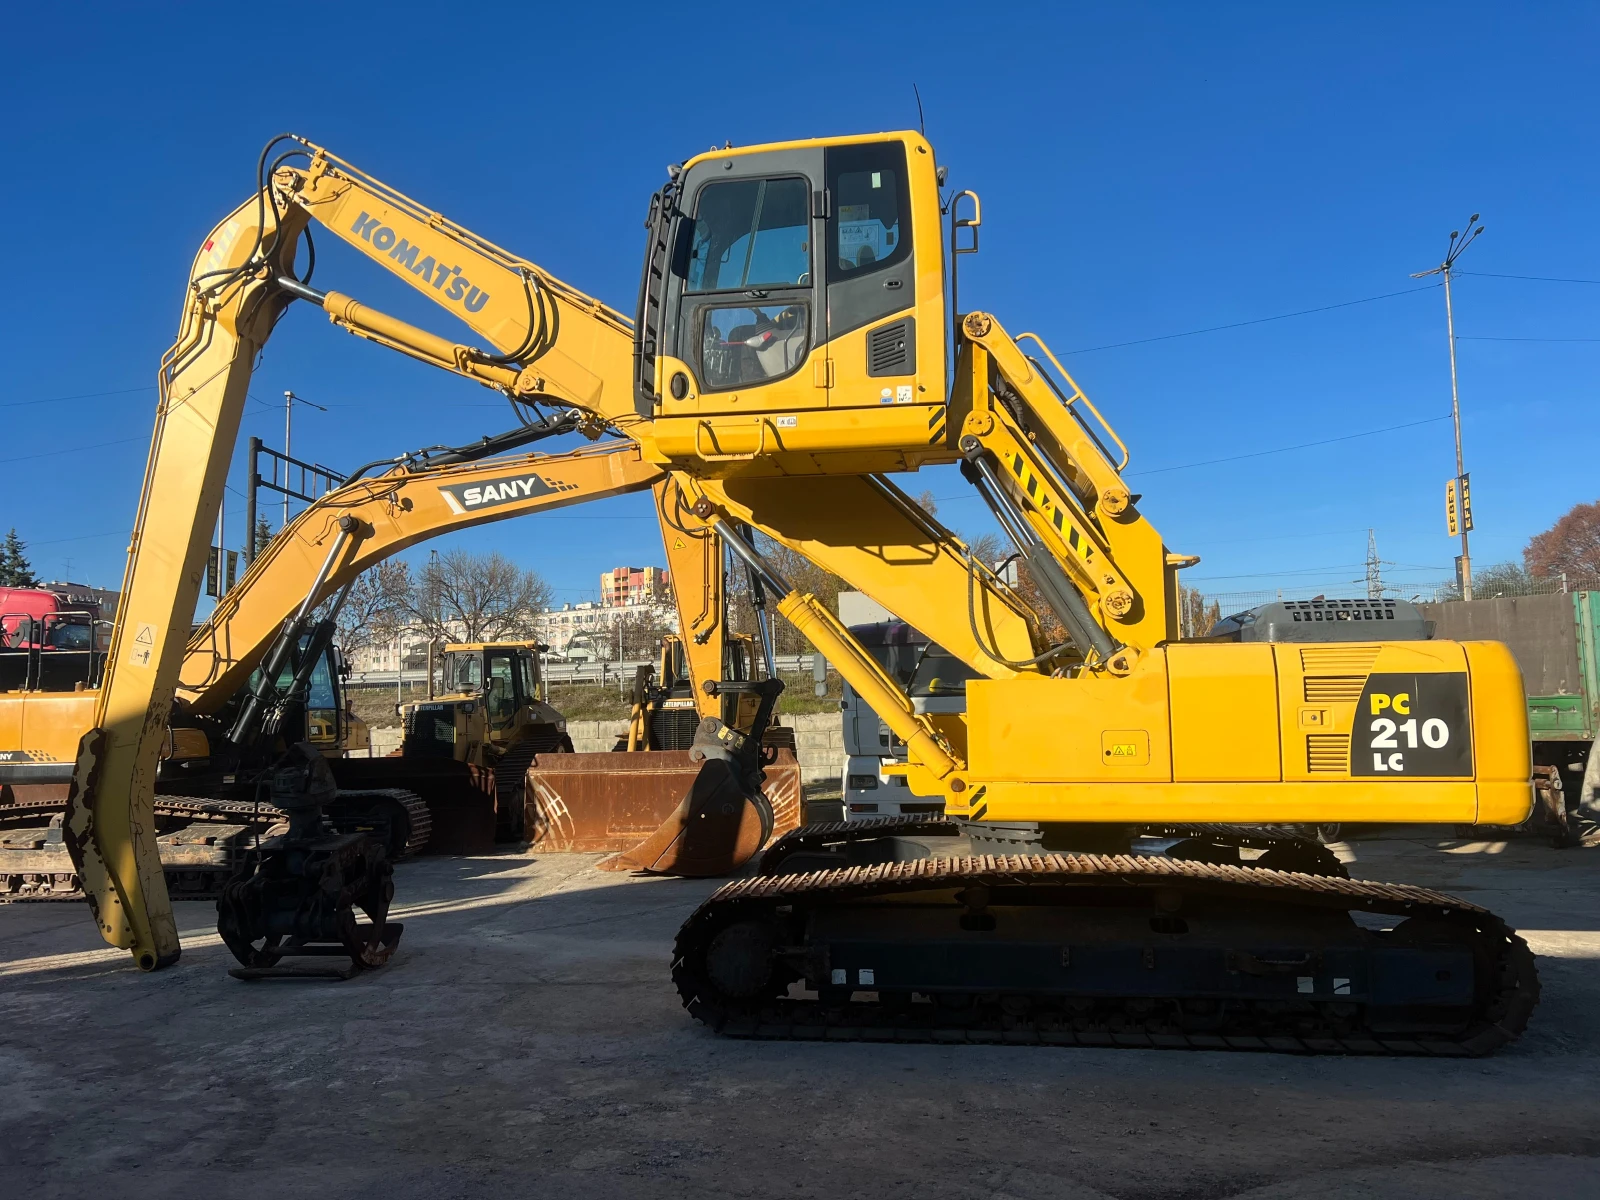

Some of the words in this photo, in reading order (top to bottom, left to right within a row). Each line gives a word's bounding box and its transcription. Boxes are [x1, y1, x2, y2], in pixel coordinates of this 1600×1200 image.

[350, 211, 490, 313] KOMATSU
[463, 477, 535, 506] SANY
[1463, 478, 1471, 529] EFBET
[1448, 485, 1456, 533] EFBET
[662, 700, 694, 708] CATERPILLAR
[1370, 693, 1410, 715] PC
[1370, 718, 1449, 749] 210
[1373, 753, 1404, 771] LC
